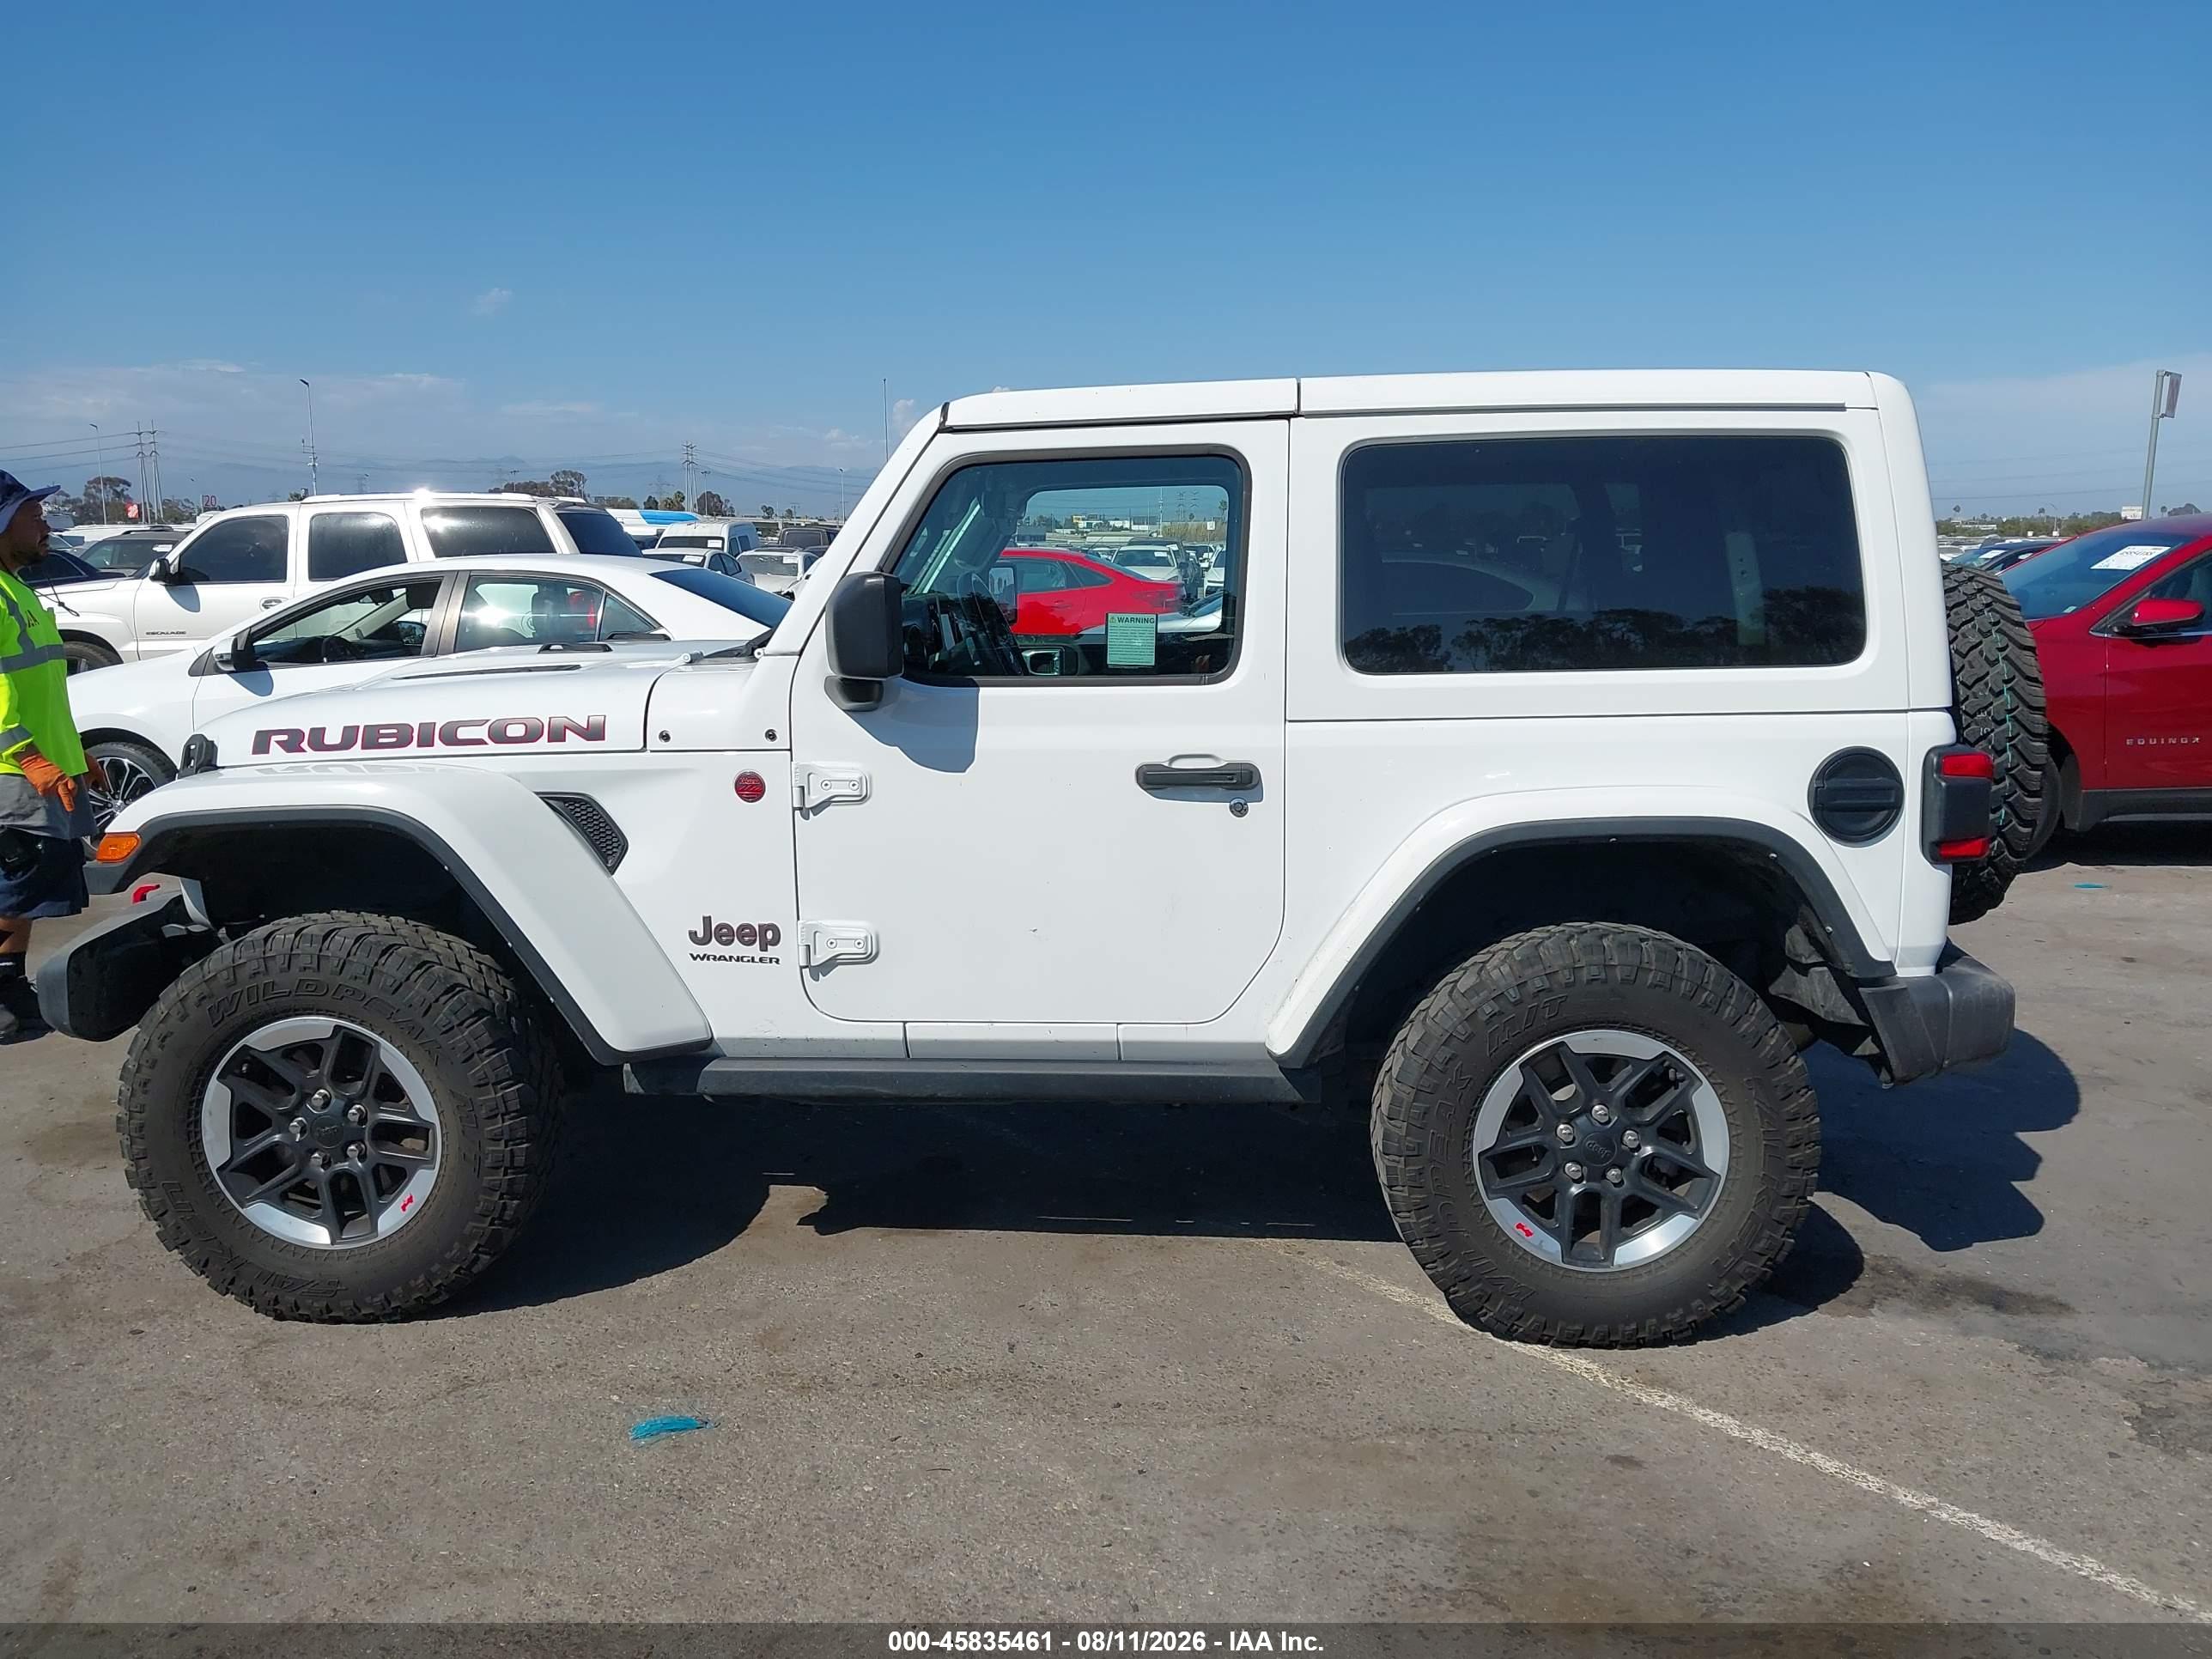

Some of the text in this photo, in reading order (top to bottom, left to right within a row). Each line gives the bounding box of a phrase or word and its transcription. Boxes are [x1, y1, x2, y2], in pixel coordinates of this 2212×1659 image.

[204, 495, 217, 507] 20
[252, 714, 606, 755] RUBICON
[2125, 737, 2200, 745] EQUINOX
[688, 915, 781, 952] Jeep
[689, 952, 781, 965] WRANGLER
